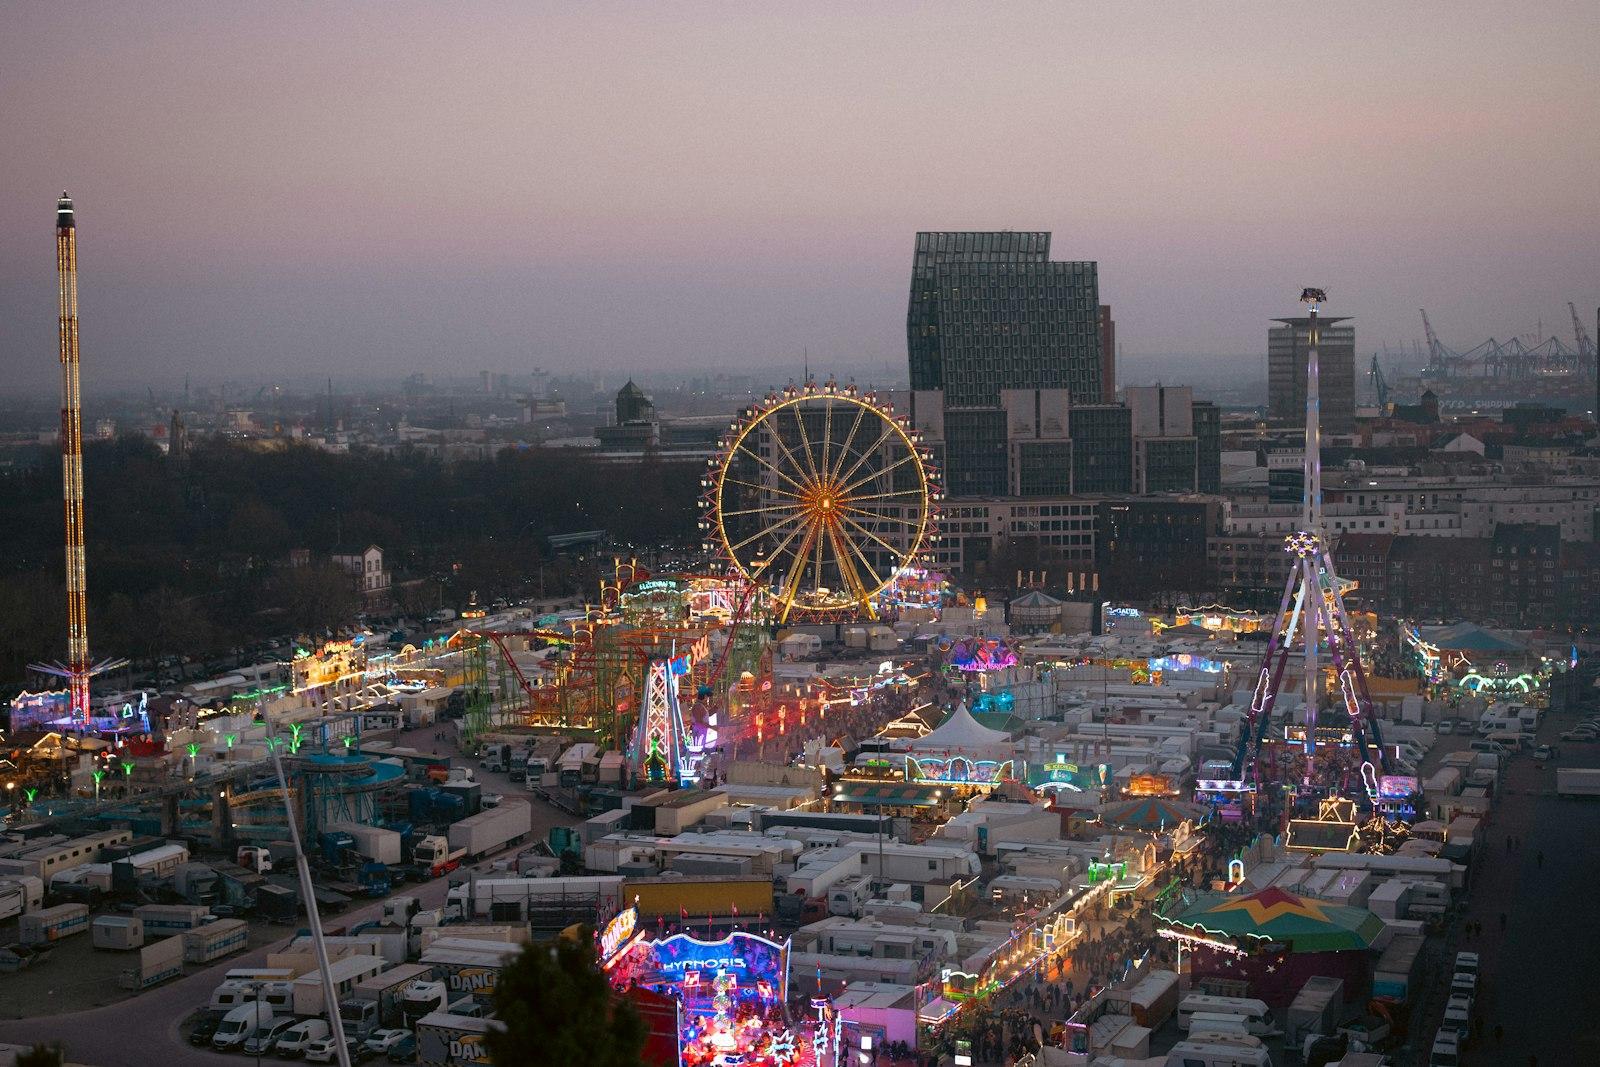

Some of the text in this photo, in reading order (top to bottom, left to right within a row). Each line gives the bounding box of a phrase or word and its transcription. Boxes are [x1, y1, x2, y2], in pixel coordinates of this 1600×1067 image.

[664, 958, 746, 970] HYPNOSIS
[450, 972, 497, 992] DANC
[450, 1041, 487, 1060] DAN
